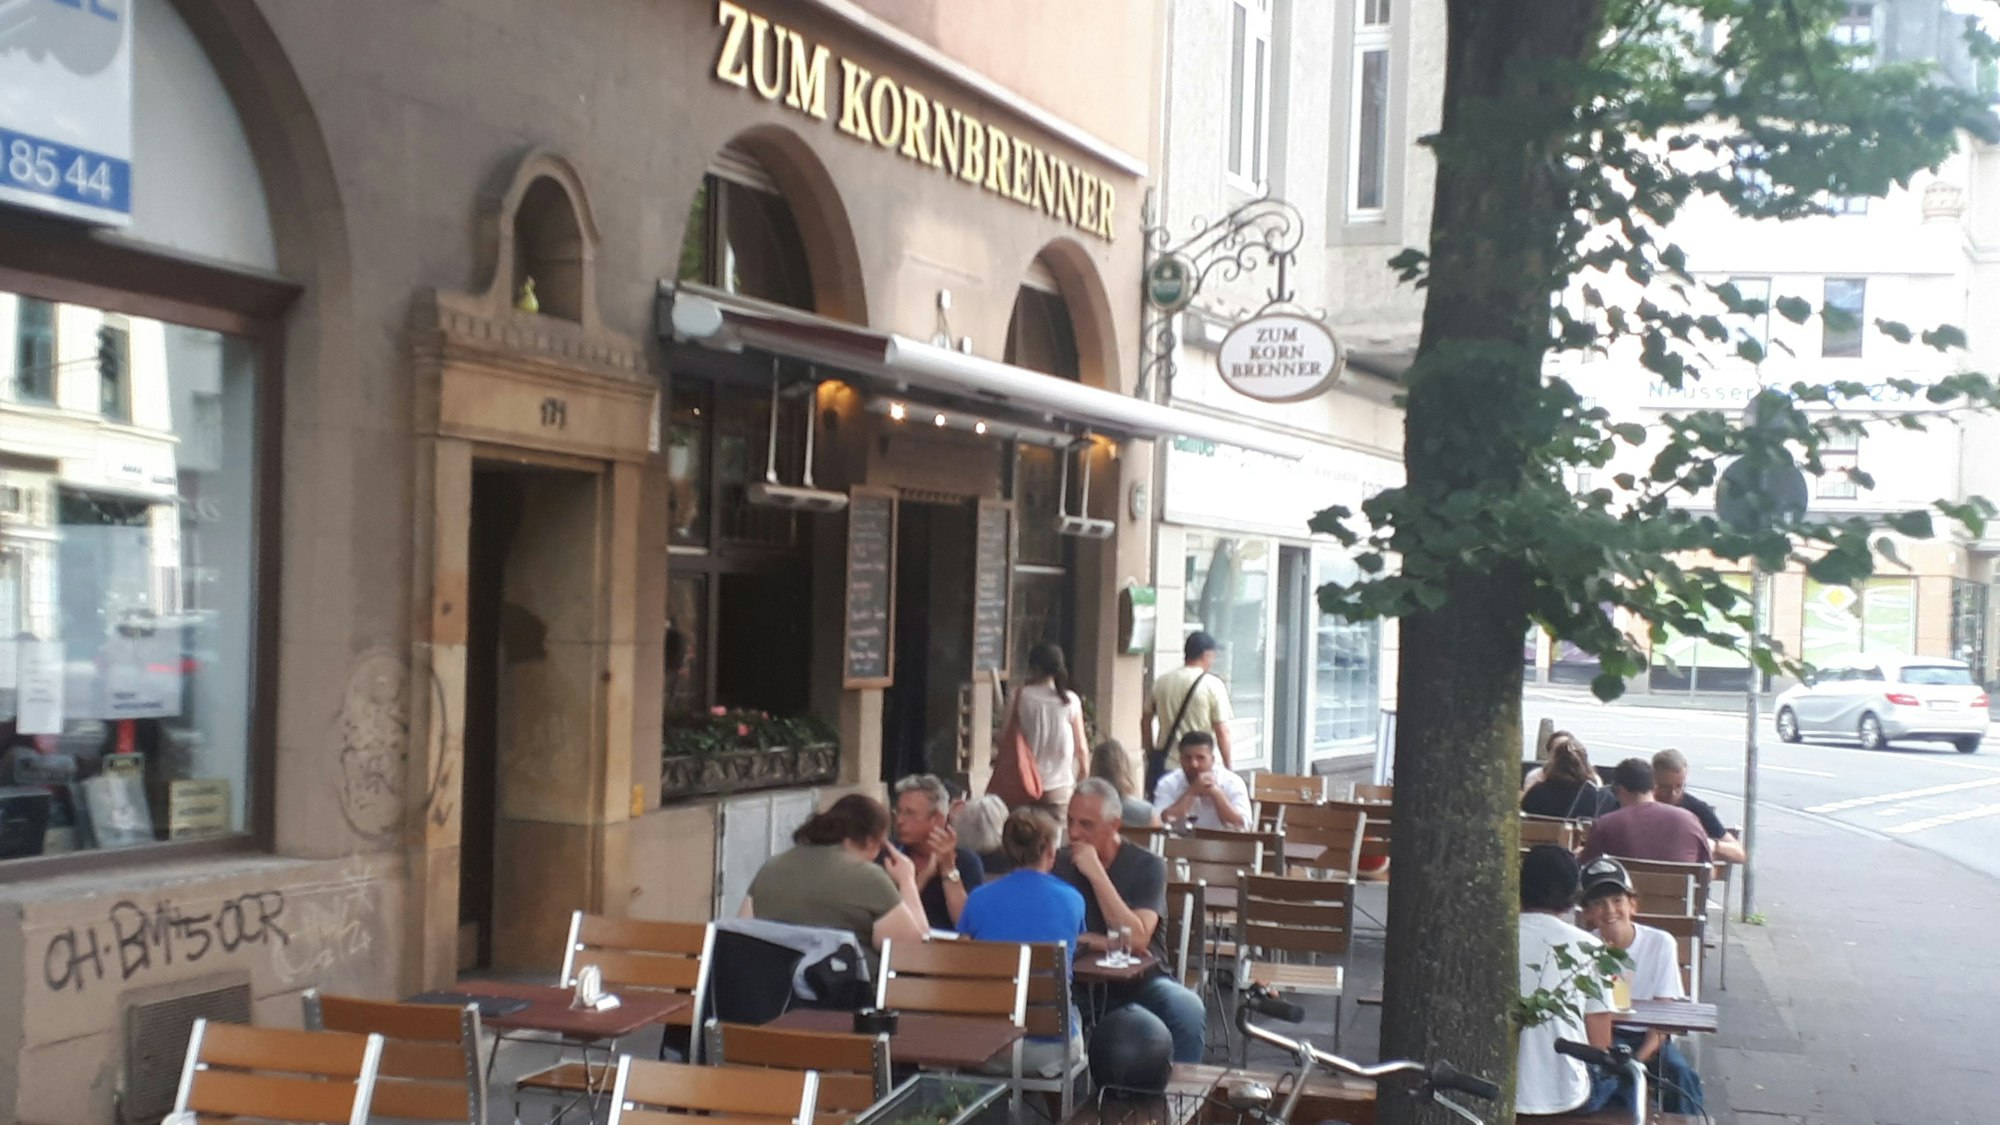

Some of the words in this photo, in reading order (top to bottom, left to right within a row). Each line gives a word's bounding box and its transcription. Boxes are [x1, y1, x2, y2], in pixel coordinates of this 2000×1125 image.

[715, 0, 831, 121] ZUM
[838, 57, 1117, 241] KORNBRENNER
[1256, 327, 1298, 343] ZUM
[1248, 345, 1305, 361] KORN
[1231, 361, 1323, 378] BRENNER
